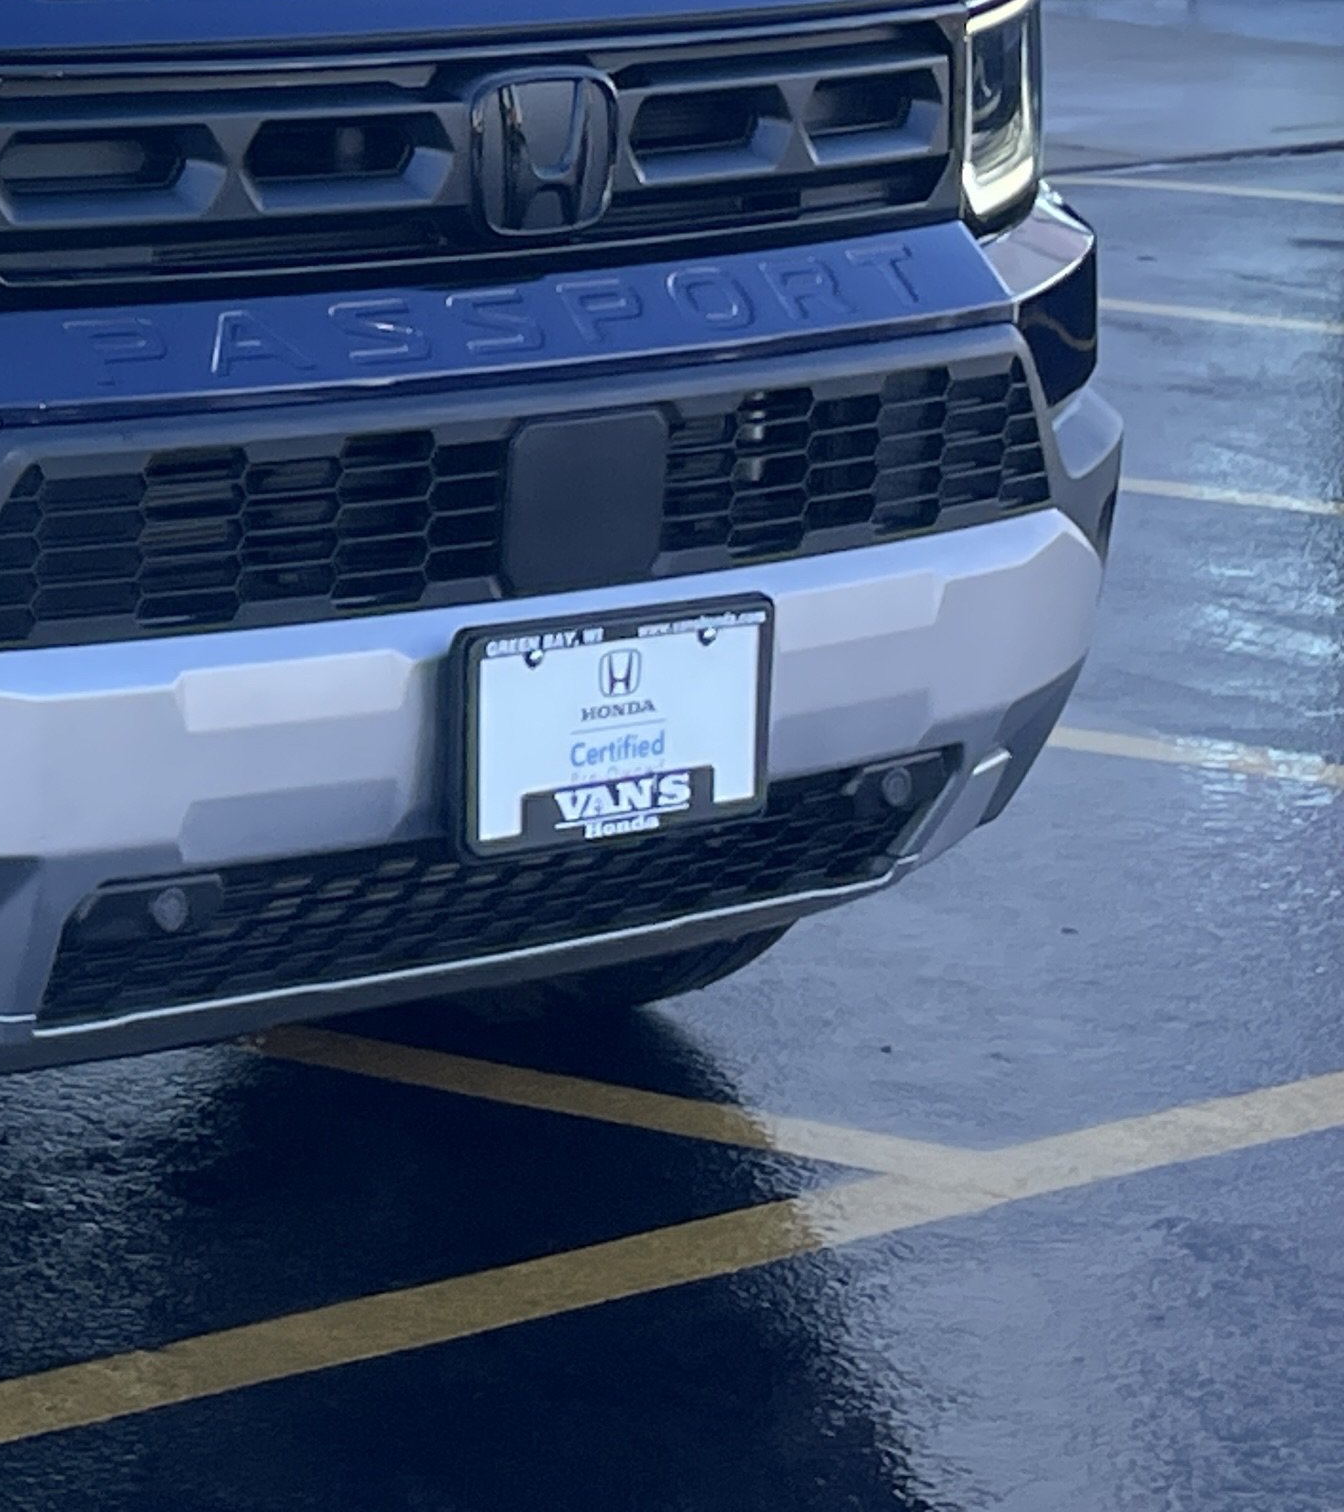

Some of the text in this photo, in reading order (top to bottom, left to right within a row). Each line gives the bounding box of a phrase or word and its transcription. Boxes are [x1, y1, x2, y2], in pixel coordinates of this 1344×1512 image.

[62, 242, 920, 387] PASSPORT
[579, 698, 657, 722] HONDA
[569, 728, 666, 767] Certified
[583, 813, 661, 840] Honda
